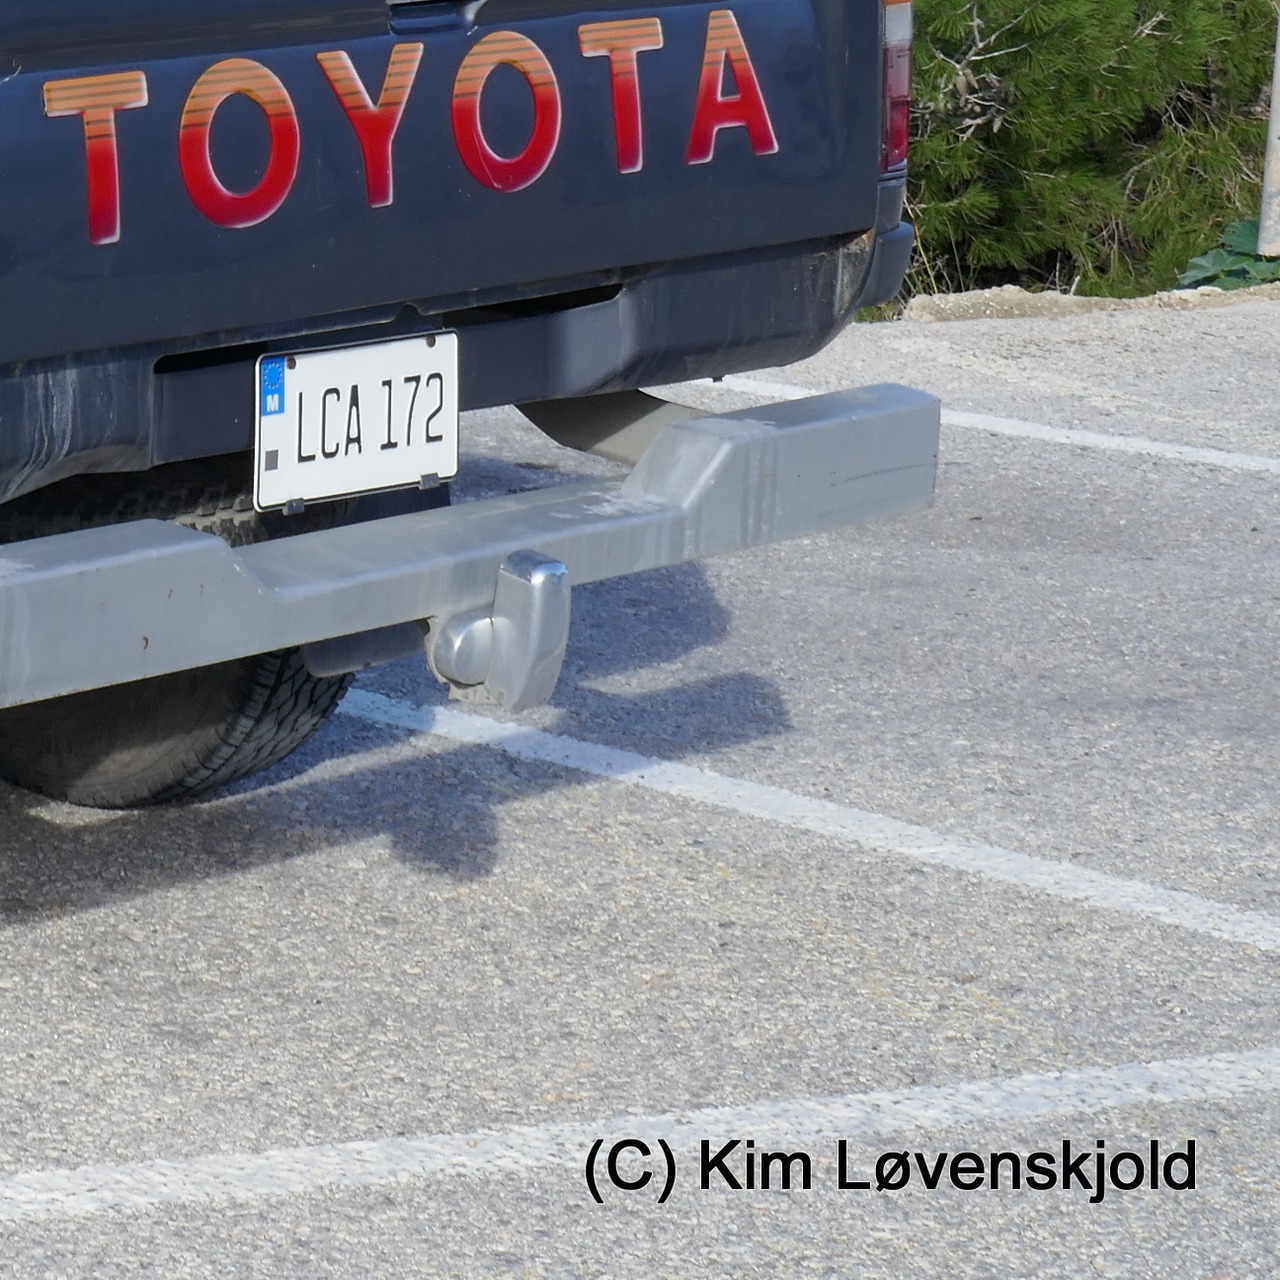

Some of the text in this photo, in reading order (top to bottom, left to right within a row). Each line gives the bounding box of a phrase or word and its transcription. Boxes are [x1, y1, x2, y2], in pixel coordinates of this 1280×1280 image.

[43, 9, 779, 245] TOYOTA
[266, 394, 279, 412] M
[297, 372, 444, 463] LCA 172
